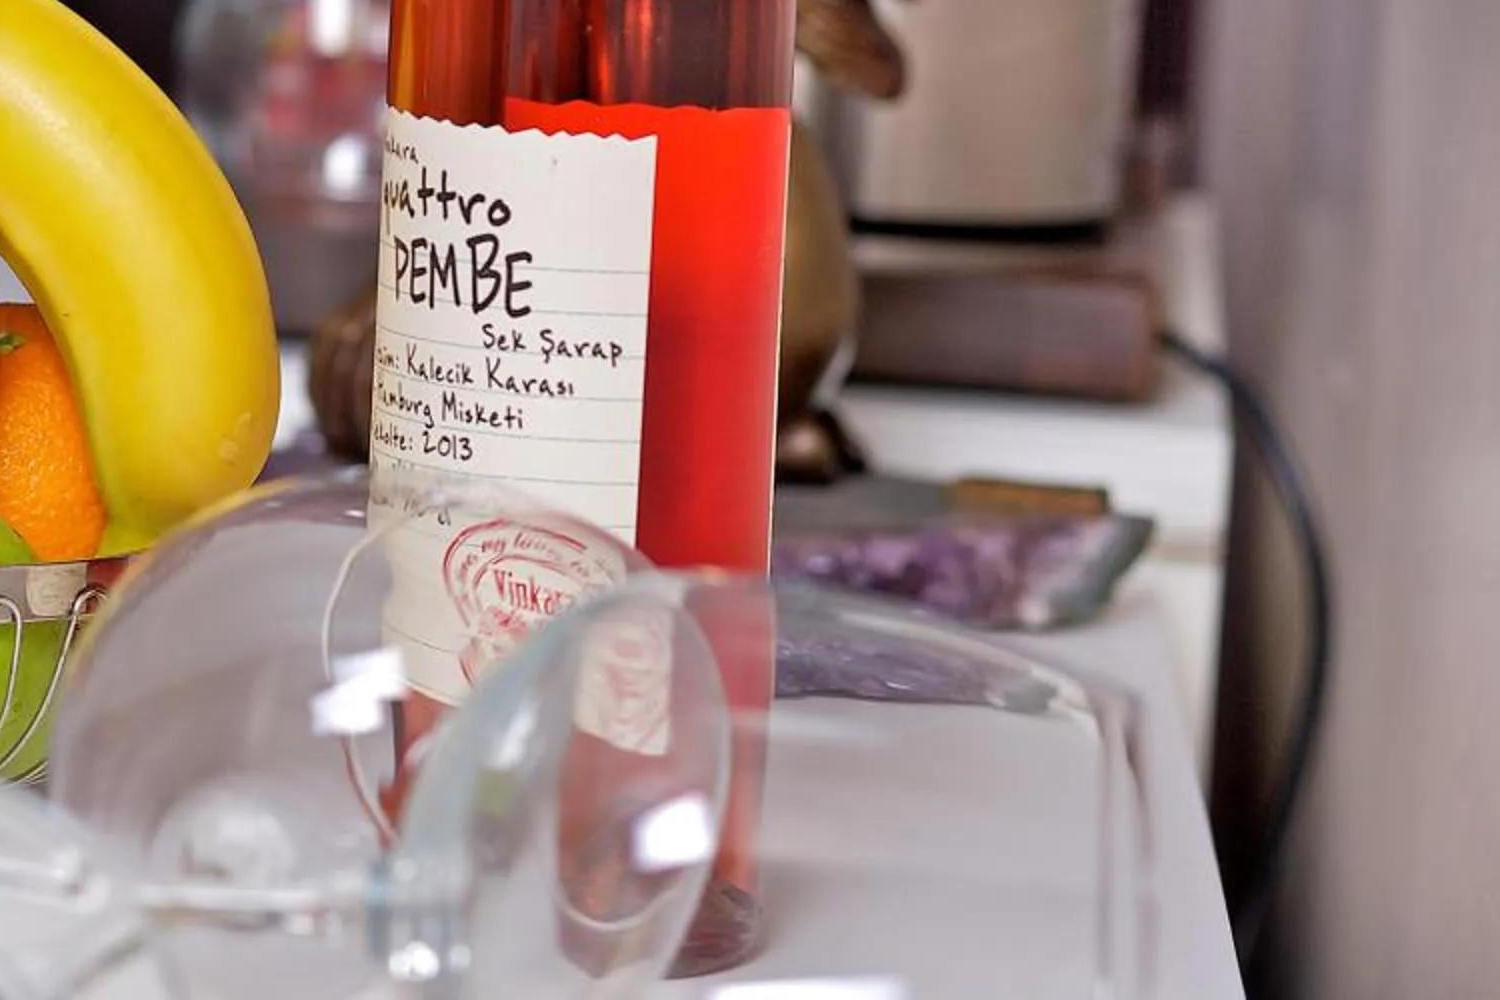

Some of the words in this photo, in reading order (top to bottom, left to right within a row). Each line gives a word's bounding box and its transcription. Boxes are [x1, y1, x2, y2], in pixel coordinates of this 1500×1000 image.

[393, 233, 533, 318] PEMBE
[481, 323, 526, 352] Sek
[539, 328, 623, 367] Şarap
[406, 343, 474, 384] Kalecik
[486, 357, 574, 398] Karası
[441, 390, 523, 429] Misketi
[422, 430, 473, 461] 2013
